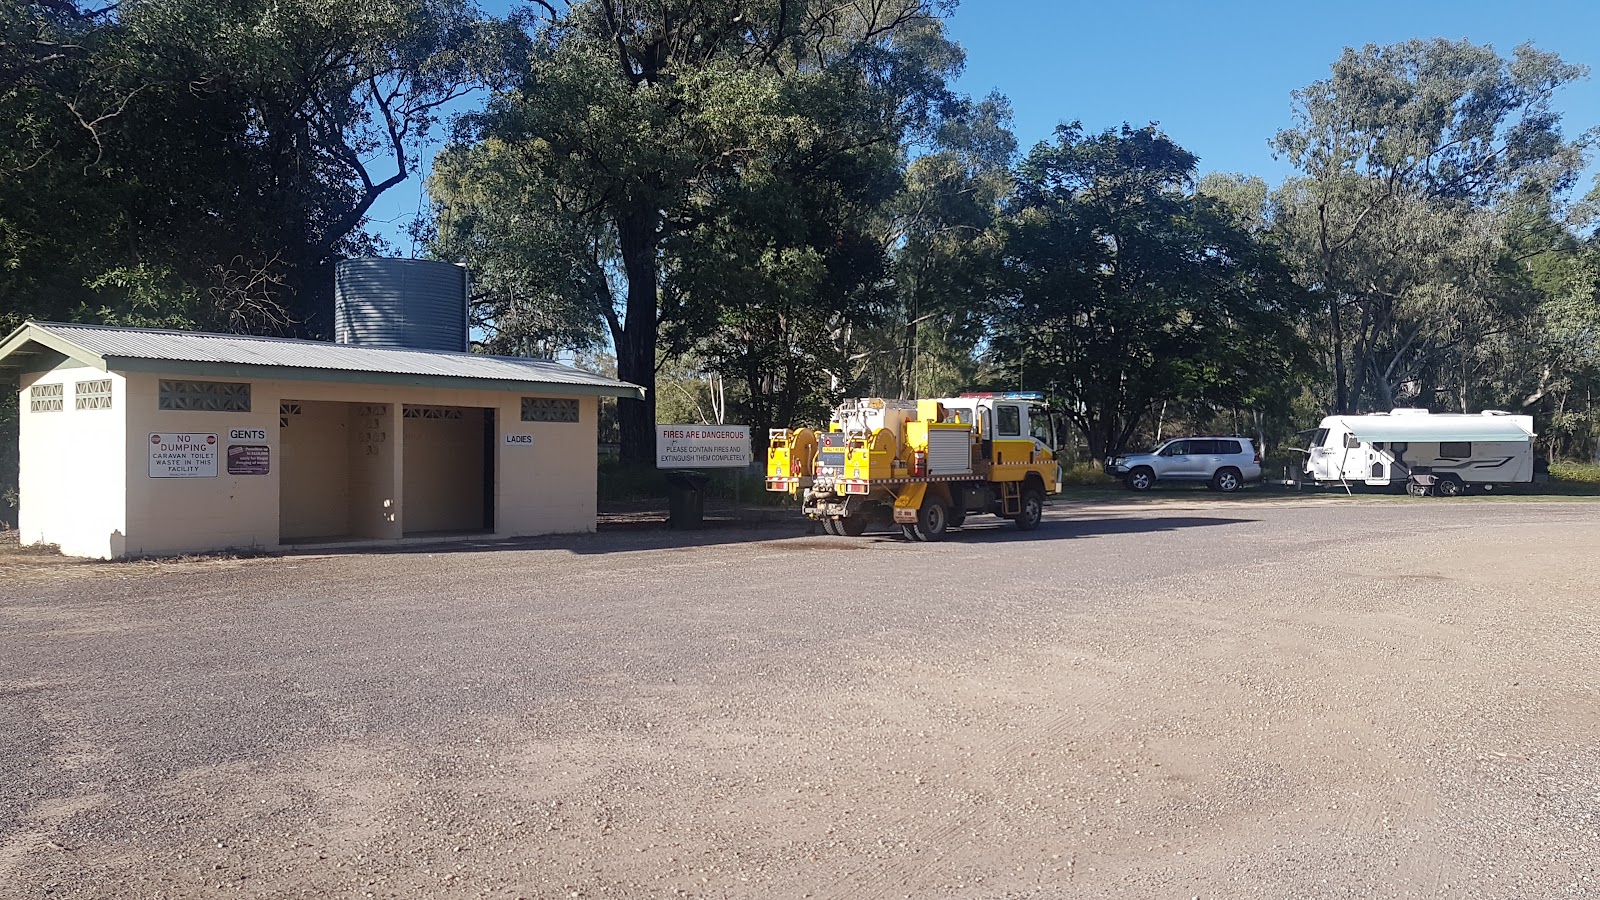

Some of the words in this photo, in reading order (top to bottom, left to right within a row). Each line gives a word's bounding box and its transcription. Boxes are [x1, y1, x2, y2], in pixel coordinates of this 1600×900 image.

[230, 430, 265, 439] GENTS
[663, 430, 684, 438] FIRES
[686, 430, 700, 438] ARE
[702, 431, 744, 439] DANGEROUS
